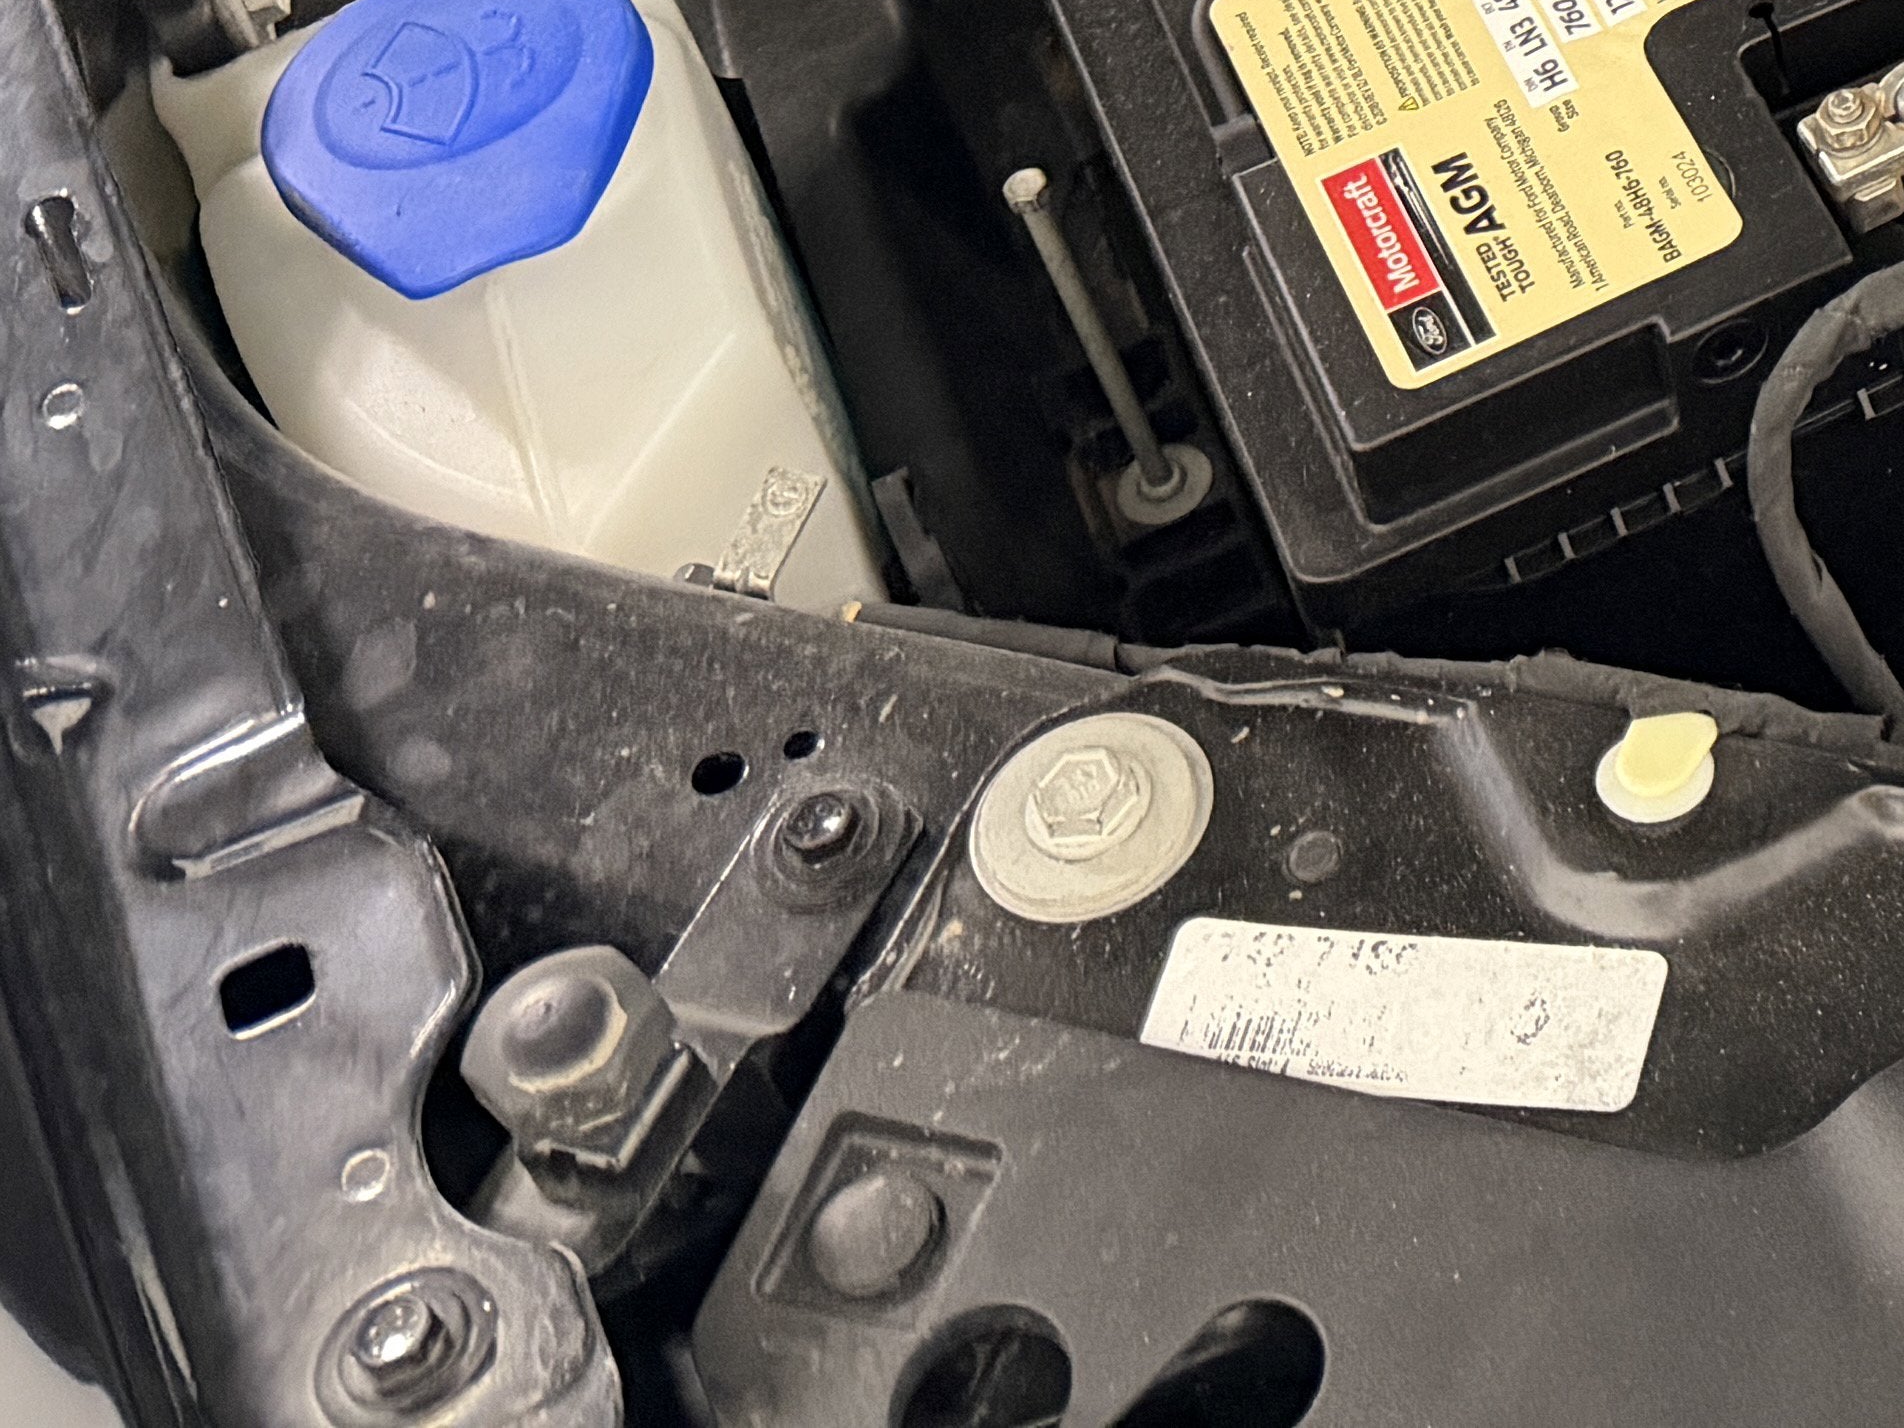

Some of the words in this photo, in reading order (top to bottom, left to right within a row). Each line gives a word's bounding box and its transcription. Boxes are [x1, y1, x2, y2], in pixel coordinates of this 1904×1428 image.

[1509, 16, 1547, 56] LN3
[1532, 58, 1567, 91] H6
[1483, 116, 1514, 160] Company
[1548, 104, 1569, 132] Group
[1510, 125, 1540, 169] Michigan
[1430, 151, 1505, 234] AGM
[1506, 158, 1528, 187] Motor
[1671, 150, 1712, 202] 103024
[1518, 184, 1541, 209] Ford
[1533, 206, 1549, 223] for
[1604, 149, 1681, 262] BAGM-48H6-760
[1661, 187, 1681, 209] Serial
[1343, 173, 1419, 293] Motorcraft
[1618, 211, 1634, 229] Part
[1475, 242, 1515, 302] TESTED
[1538, 220, 1585, 289] Manufactured
[1572, 238, 1605, 284] American
